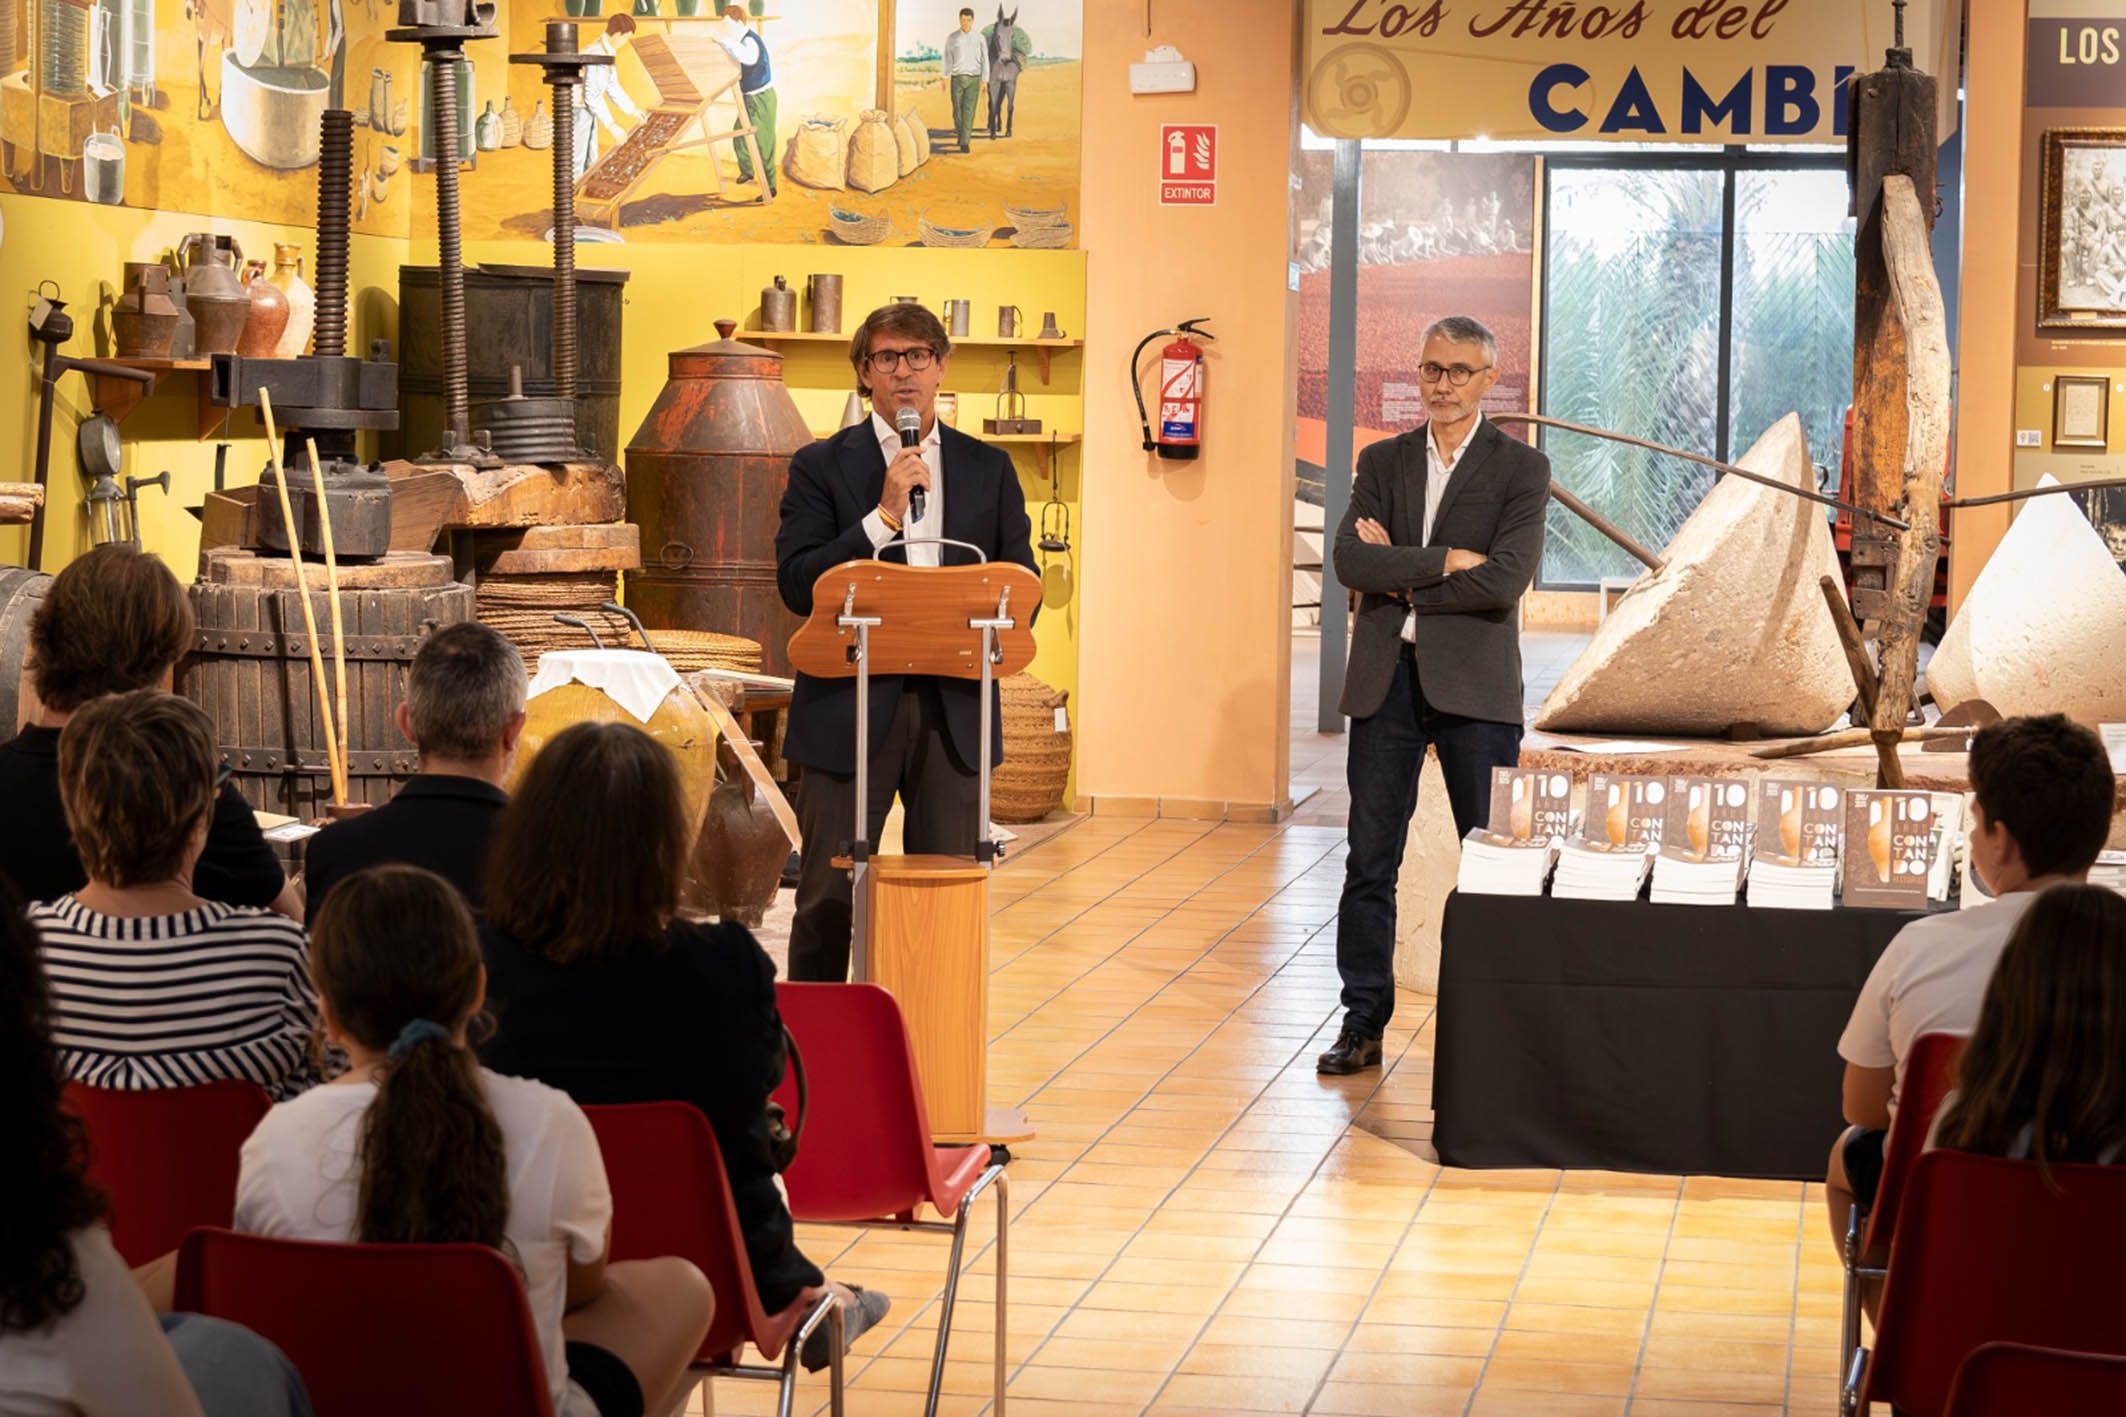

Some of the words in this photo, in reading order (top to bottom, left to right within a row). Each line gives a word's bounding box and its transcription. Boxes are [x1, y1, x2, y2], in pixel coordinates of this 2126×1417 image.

[1322, 0, 1450, 38] Los
[1468, 0, 1652, 39] Años
[1671, 0, 1789, 40] del
[2059, 26, 2120, 65] LOS
[1528, 63, 1854, 136] CAMBI
[1164, 187, 1212, 200] EXTINTOR
[1536, 774, 1569, 799] 10
[1632, 781, 1665, 805] 10
[1714, 783, 1746, 807] 10
[1806, 786, 1839, 811] 10
[1894, 797, 1929, 822] 10
[1535, 811, 1567, 823] CON
[1630, 817, 1663, 829] CON
[1535, 823, 1567, 835] TAN
[1711, 820, 1745, 832] CON
[1803, 823, 1837, 835] CON
[1630, 829, 1662, 841] TAN
[1711, 832, 1744, 844] TAN
[1802, 834, 1836, 847] TAN
[1893, 834, 1928, 847] CON
[1893, 847, 1928, 860] TAN
[1893, 859, 1926, 875] DO
